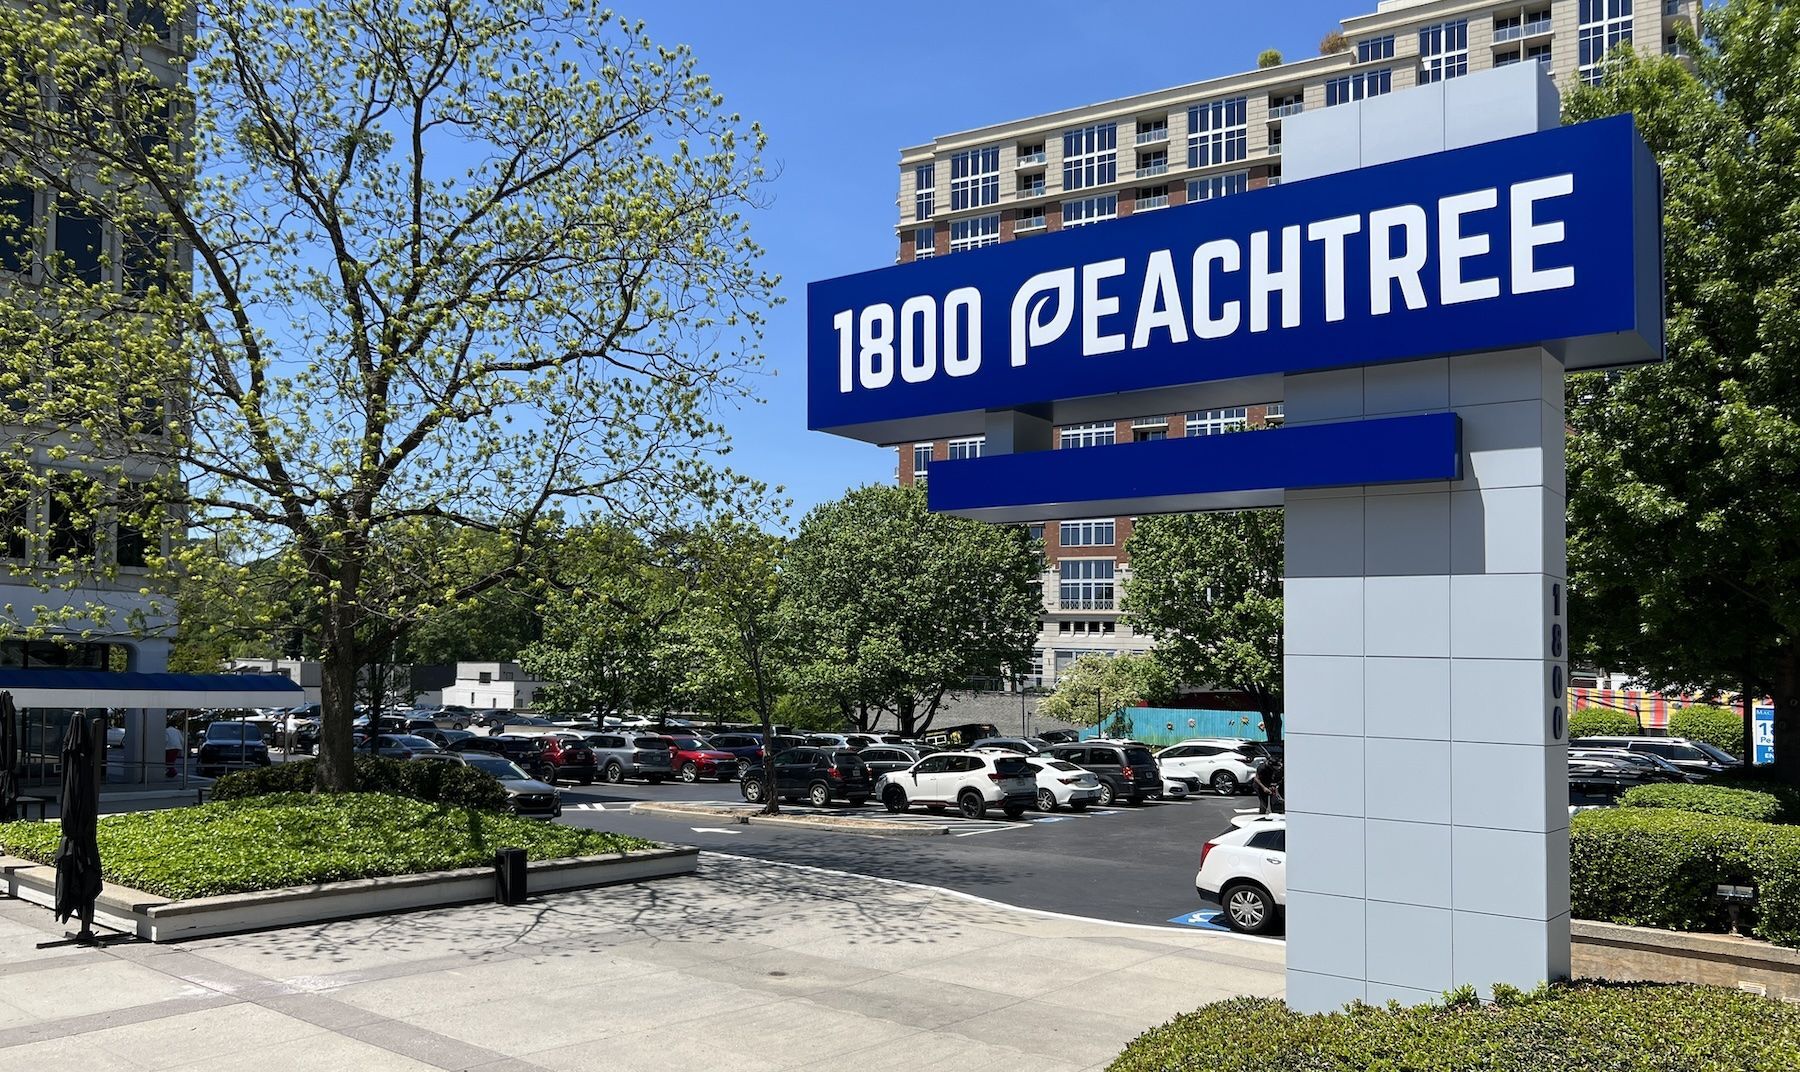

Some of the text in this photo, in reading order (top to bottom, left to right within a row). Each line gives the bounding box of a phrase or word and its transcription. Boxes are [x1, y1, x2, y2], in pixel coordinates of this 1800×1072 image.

[833, 173, 1576, 394] 1800 PEACHTREE
[1552, 583, 1563, 740] 1800
